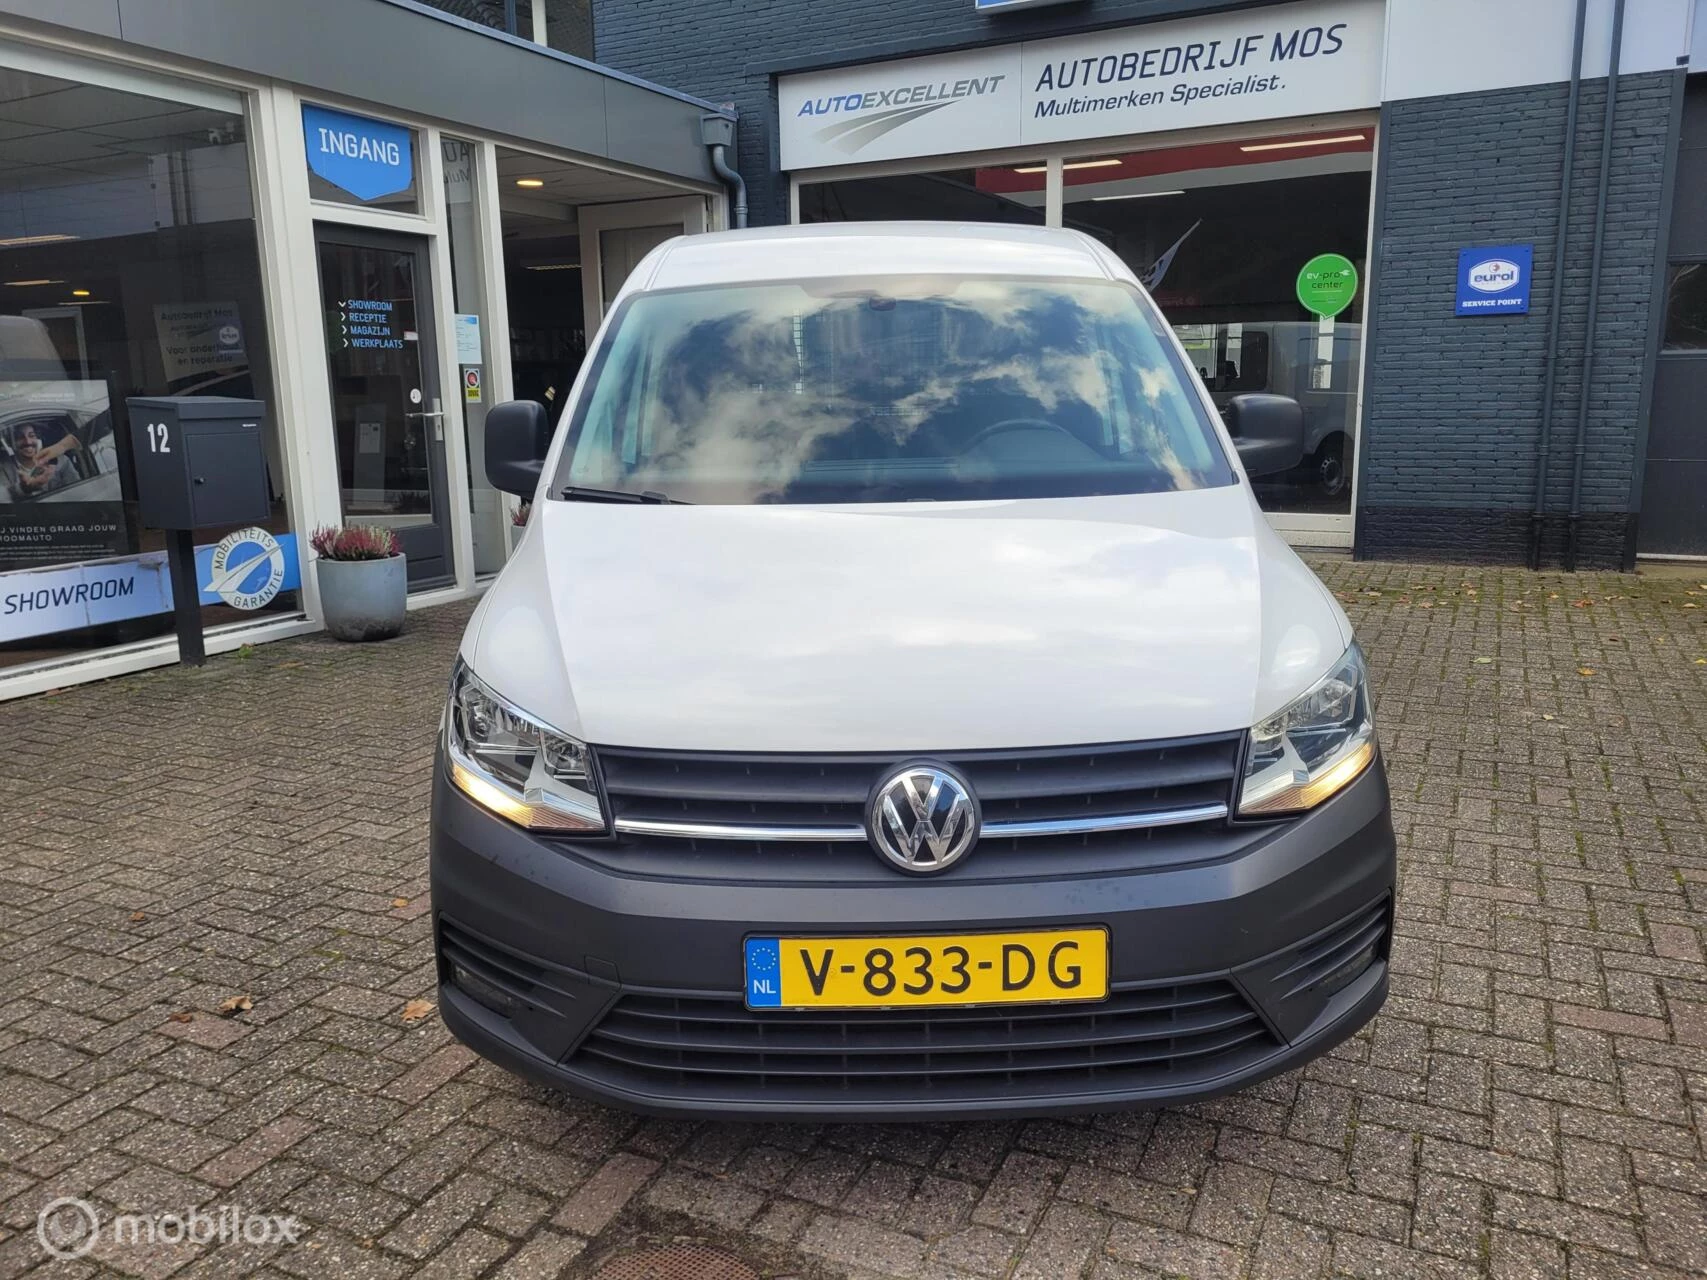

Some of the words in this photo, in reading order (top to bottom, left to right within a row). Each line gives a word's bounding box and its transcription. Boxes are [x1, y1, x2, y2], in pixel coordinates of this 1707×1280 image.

[1035, 34, 1264, 92] AUTOBEDRIJF
[1269, 23, 1347, 62] MOS
[797, 75, 1006, 117] AUTOEXCELLENT
[1034, 90, 1164, 118] Multimerken
[1170, 74, 1286, 106] Specialist.
[318, 127, 400, 166] INGANG
[1306, 271, 1341, 281] ev-pro
[1474, 270, 1515, 283] eurol
[1311, 281, 1344, 289] center
[347, 299, 393, 311] SHOWROOM
[1462, 300, 1496, 308] SERVICE
[1497, 298, 1522, 306] POINT
[349, 312, 387, 324] RECEPTIE
[350, 325, 391, 336] MAGAZIJN
[351, 339, 404, 349] WERKPLAATS
[147, 423, 171, 453] 12
[10, 526, 46, 534] VINDEN
[50, 524, 85, 533] GRAAG
[88, 524, 117, 532] JOUW
[214, 529, 274, 570] MOBILITEITS
[4, 576, 134, 615] SHOWROOM
[233, 568, 283, 608] GARANTIE
[799, 940, 1082, 996] V-833-DG
[753, 979, 777, 995] NL
